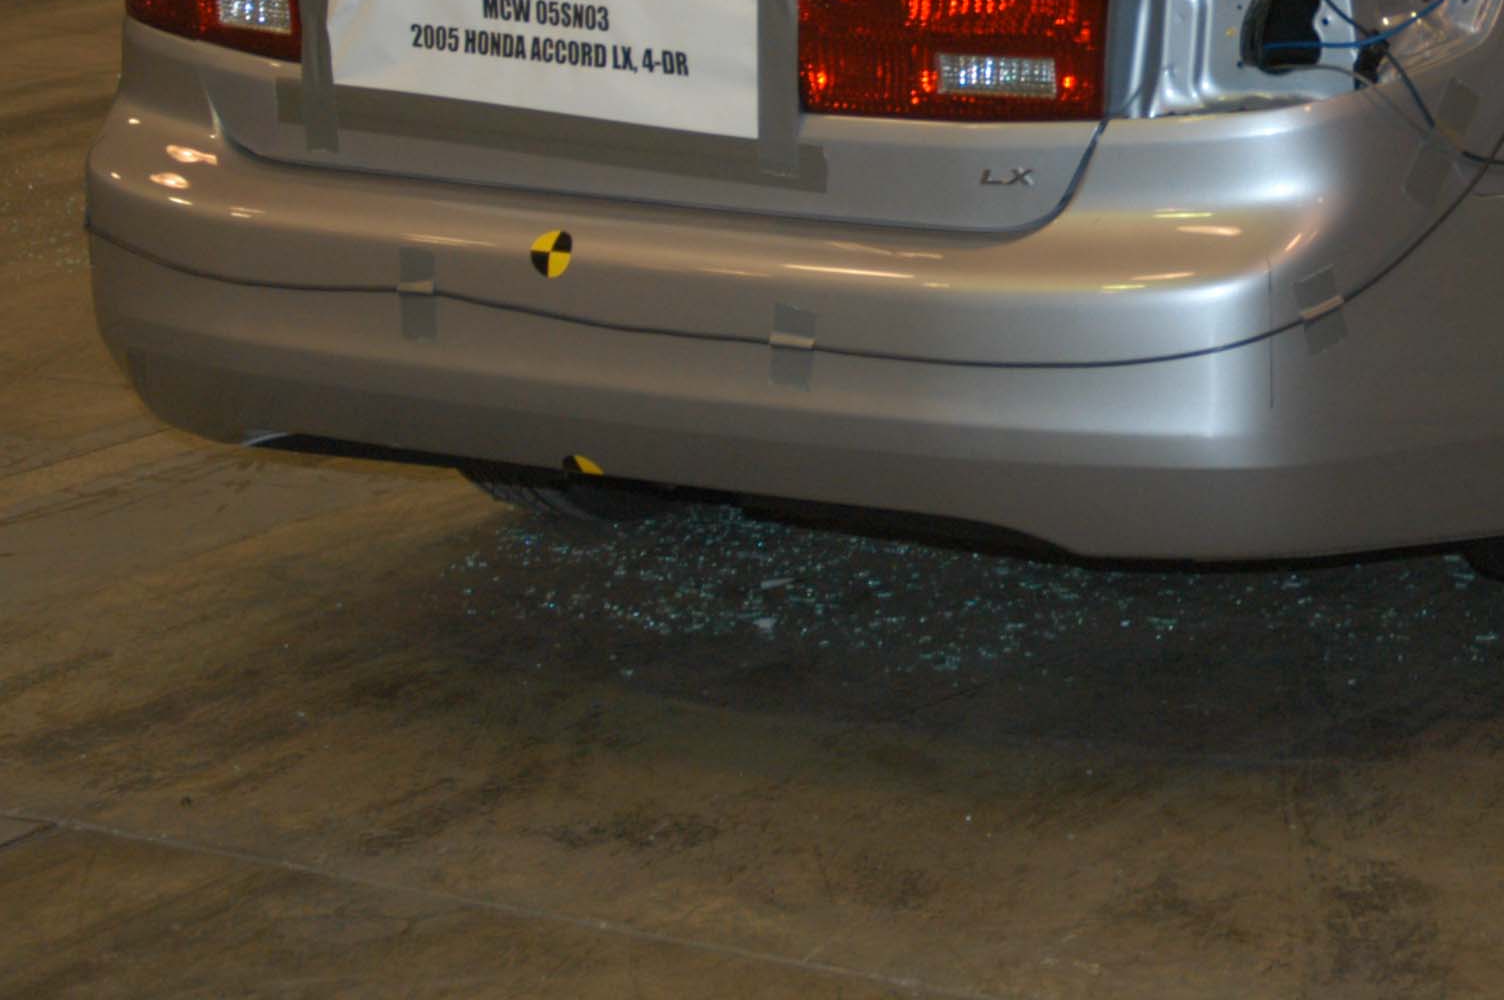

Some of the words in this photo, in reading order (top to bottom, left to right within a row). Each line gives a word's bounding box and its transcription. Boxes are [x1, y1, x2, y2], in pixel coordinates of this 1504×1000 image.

[410, 23, 460, 53] 2005
[463, 28, 527, 60] HONDA
[530, 36, 607, 69] ACCORD
[612, 43, 639, 73] LX,
[641, 47, 690, 77] 4-DR
[980, 168, 1034, 186] LX
